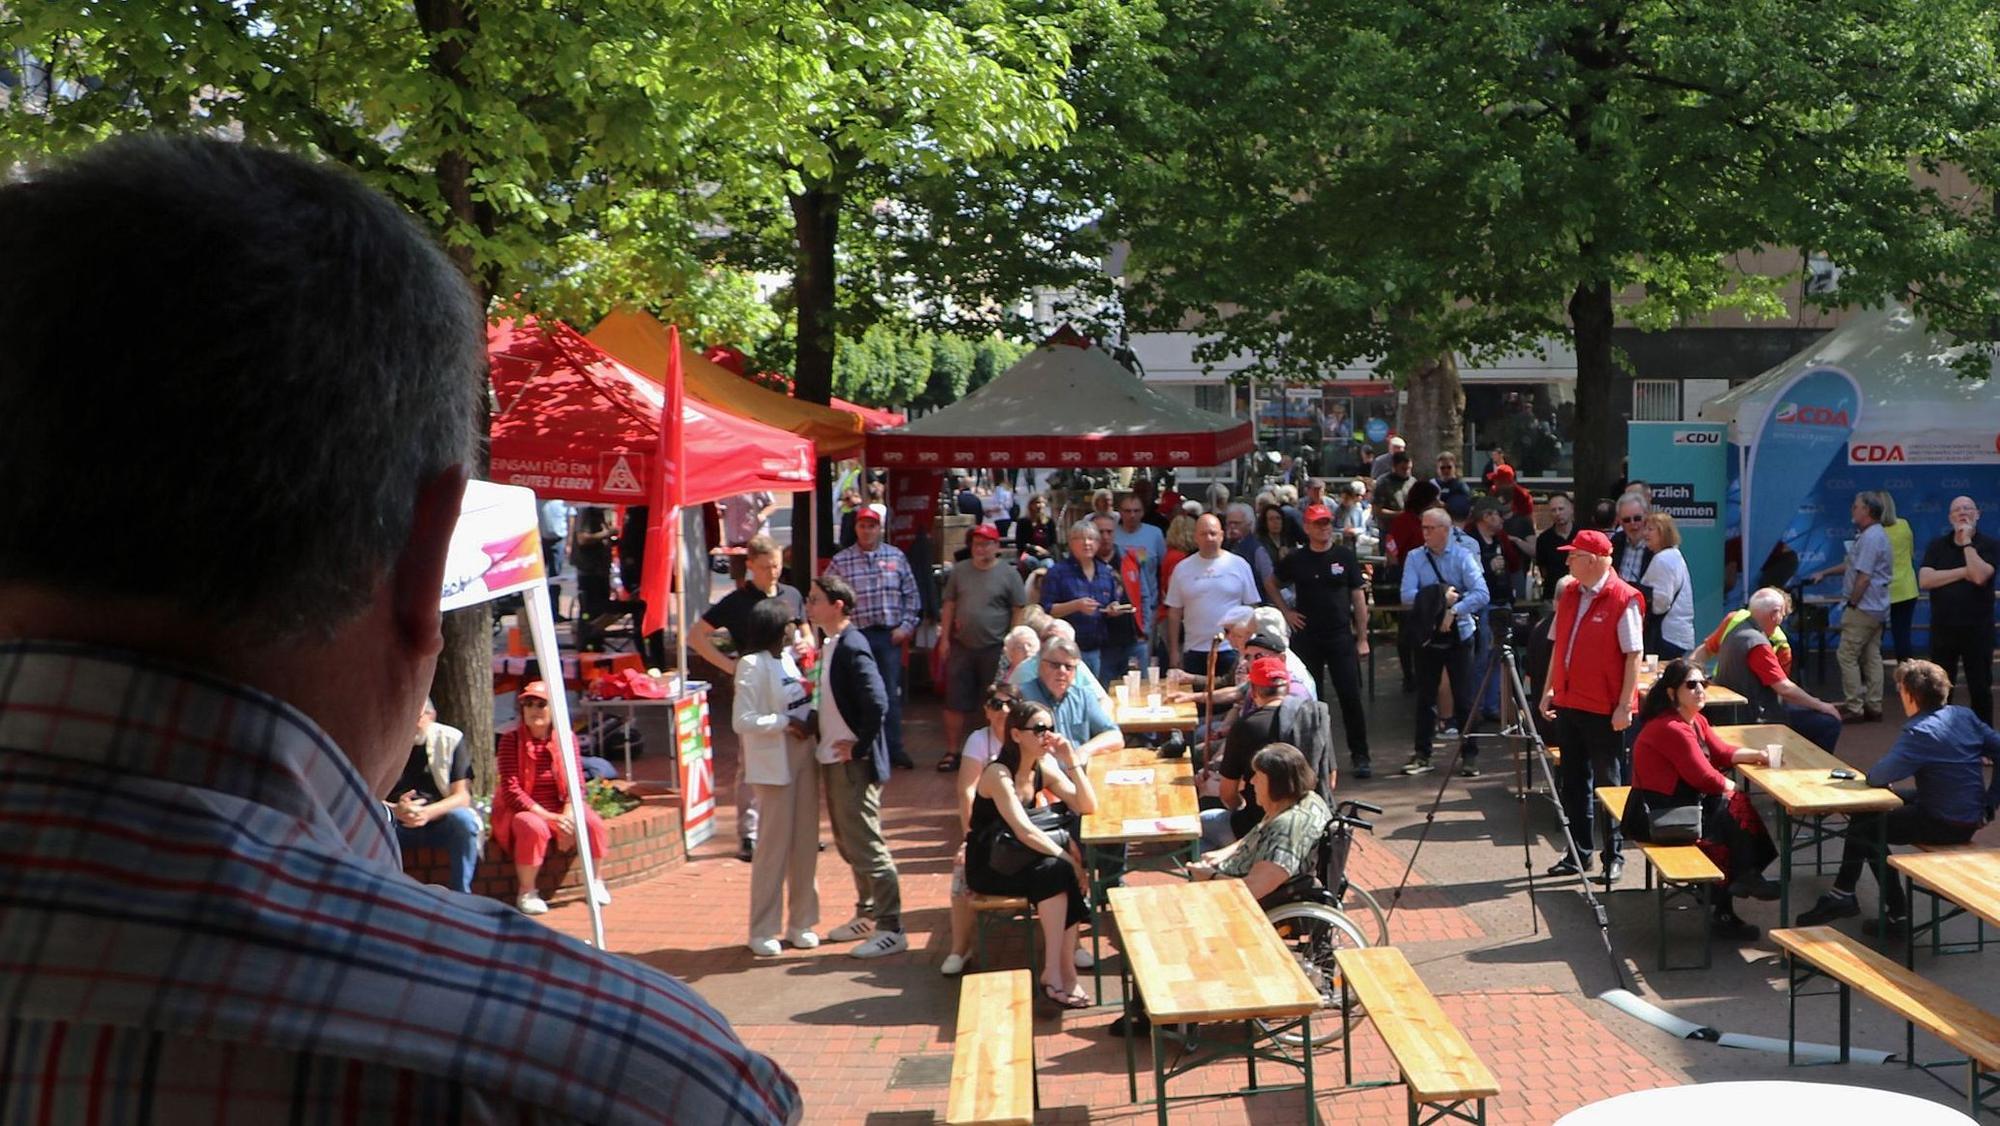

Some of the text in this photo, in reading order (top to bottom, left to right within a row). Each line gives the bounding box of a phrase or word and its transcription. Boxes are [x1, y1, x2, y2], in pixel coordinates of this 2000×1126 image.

[1798, 406, 1849, 428] CDA
[1686, 432, 1719, 444] CDU
[1850, 444, 1905, 462] CDA
[490, 457, 593, 476] EINSAM FÜR EIN
[509, 473, 594, 491] GUTES LEBEN
[1651, 486, 1690, 498] rzlich
[1653, 504, 1714, 516] lkommen
